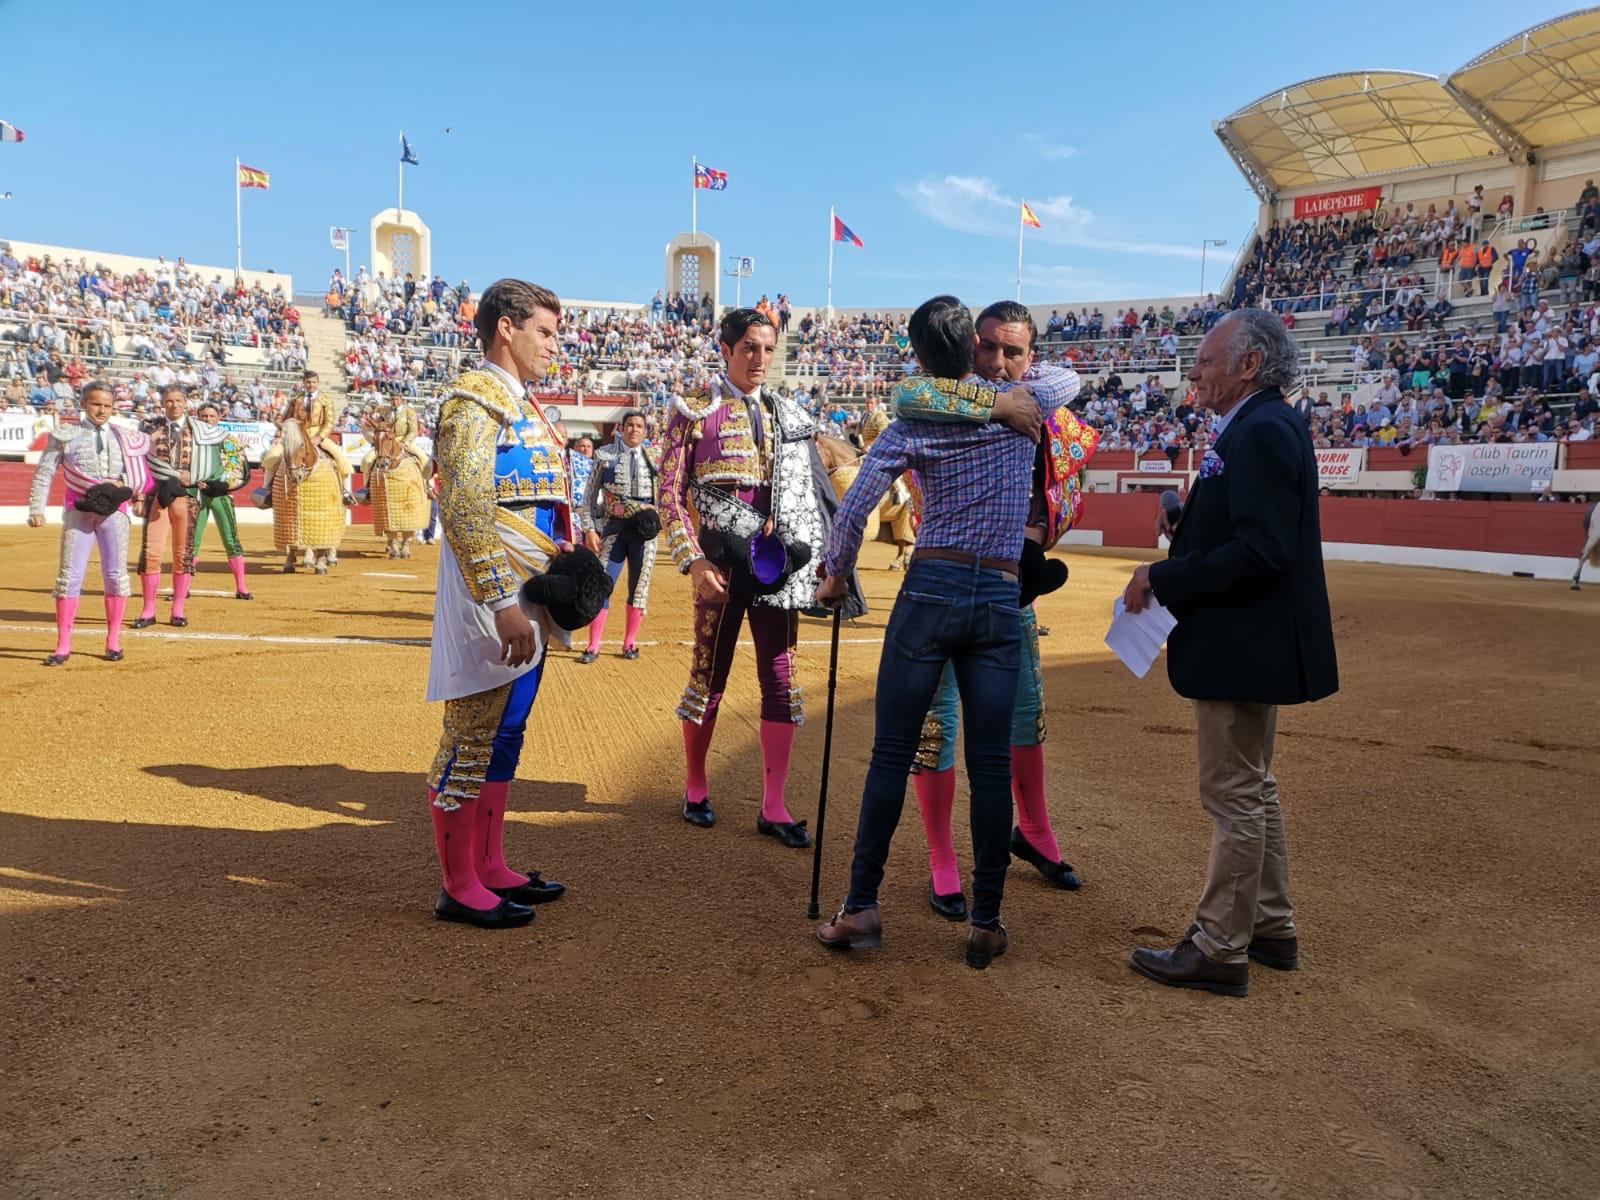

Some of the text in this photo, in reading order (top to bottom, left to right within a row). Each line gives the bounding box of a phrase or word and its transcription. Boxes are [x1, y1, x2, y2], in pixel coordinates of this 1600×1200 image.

[742, 257, 751, 269] R
[1472, 445, 1548, 460] Club Taurin
[1318, 464, 1352, 475] OUSE
[1466, 463, 1552, 478] Joseph Peyré
